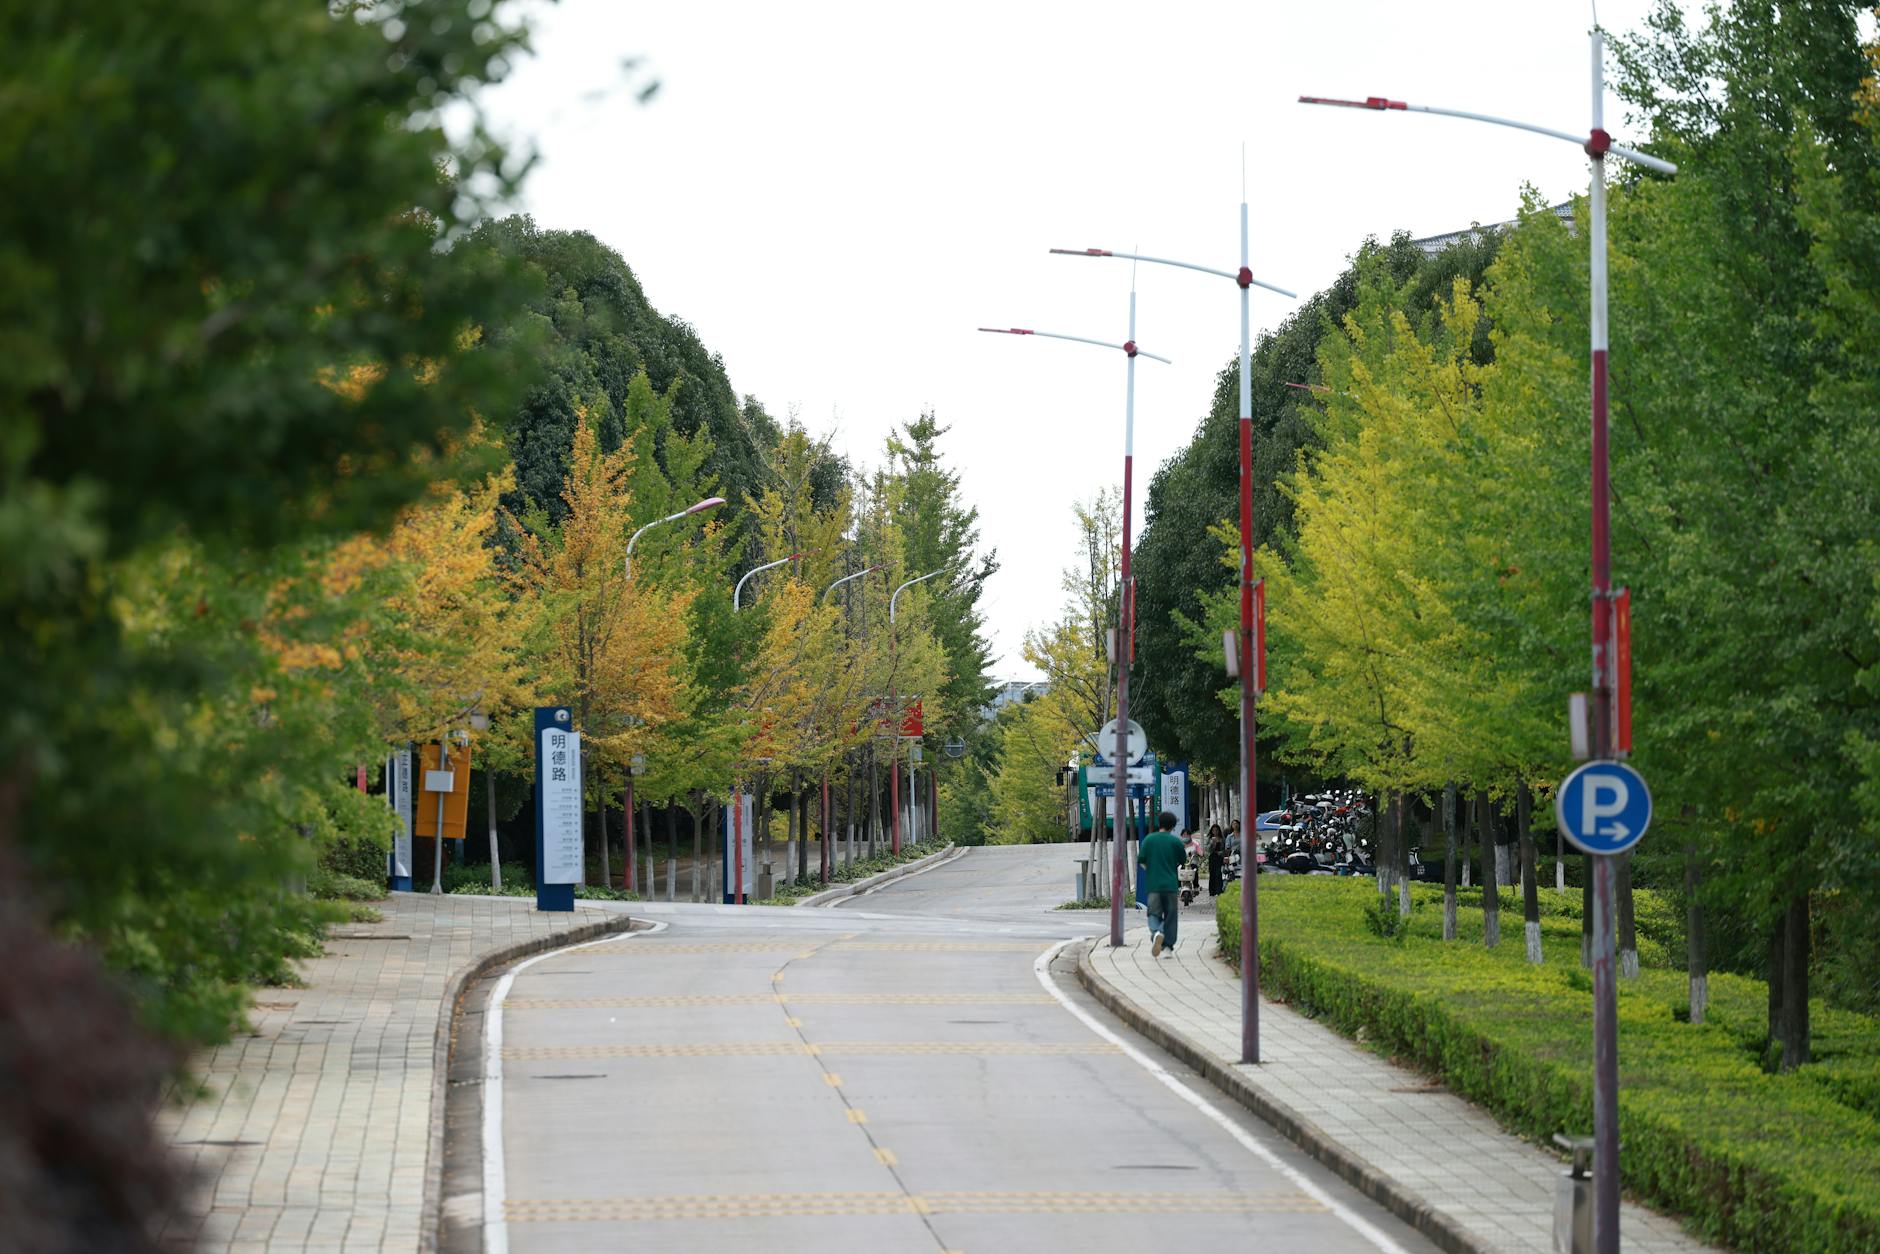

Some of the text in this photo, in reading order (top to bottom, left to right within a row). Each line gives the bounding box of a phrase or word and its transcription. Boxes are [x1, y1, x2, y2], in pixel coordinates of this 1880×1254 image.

[551, 734, 567, 782] 明德路
[1170, 775, 1179, 805] 明德路
[1581, 774, 1629, 836] P
